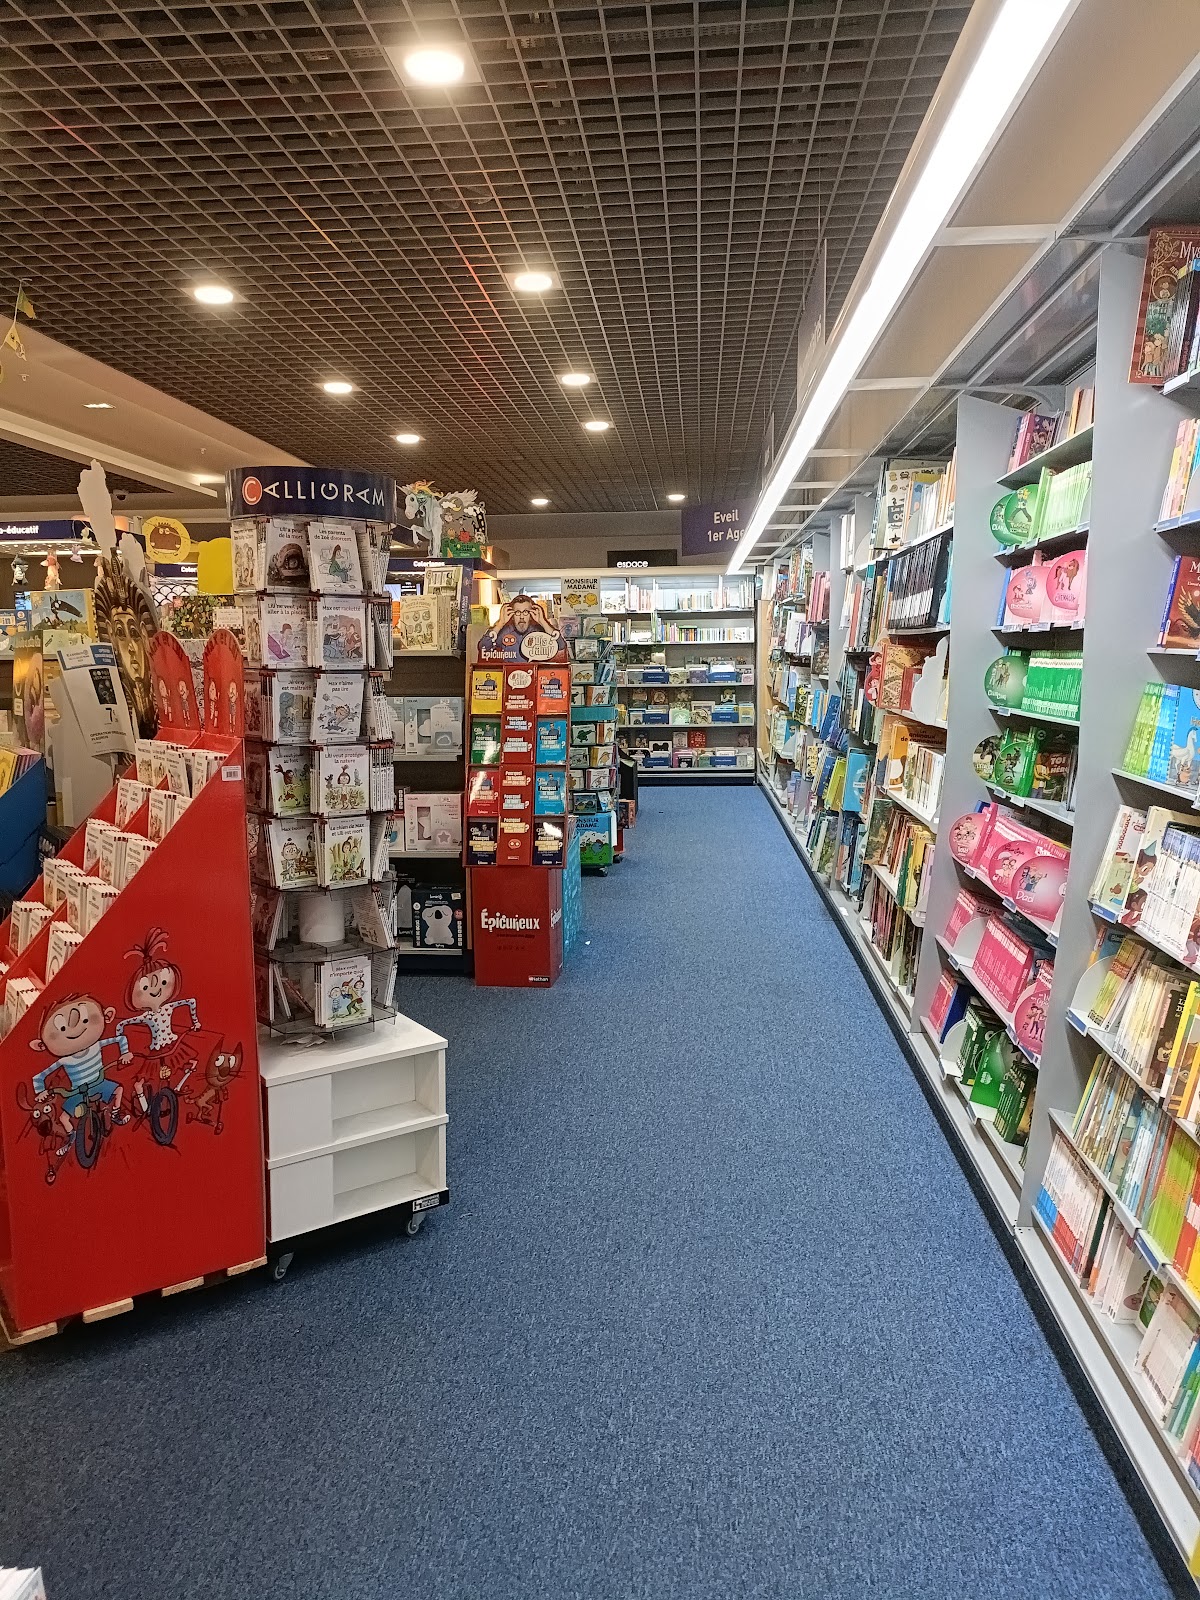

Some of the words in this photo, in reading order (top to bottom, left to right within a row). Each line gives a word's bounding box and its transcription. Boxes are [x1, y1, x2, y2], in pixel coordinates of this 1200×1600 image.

[242, 477, 385, 507] CALLIGRAM
[713, 509, 739, 524] Eveil
[707, 530, 724, 542] 1er
[726, 528, 745, 541] Age
[616, 560, 649, 569] espace
[1015, 890, 1035, 903] Dad
[480, 908, 540, 933] Épicurieux
